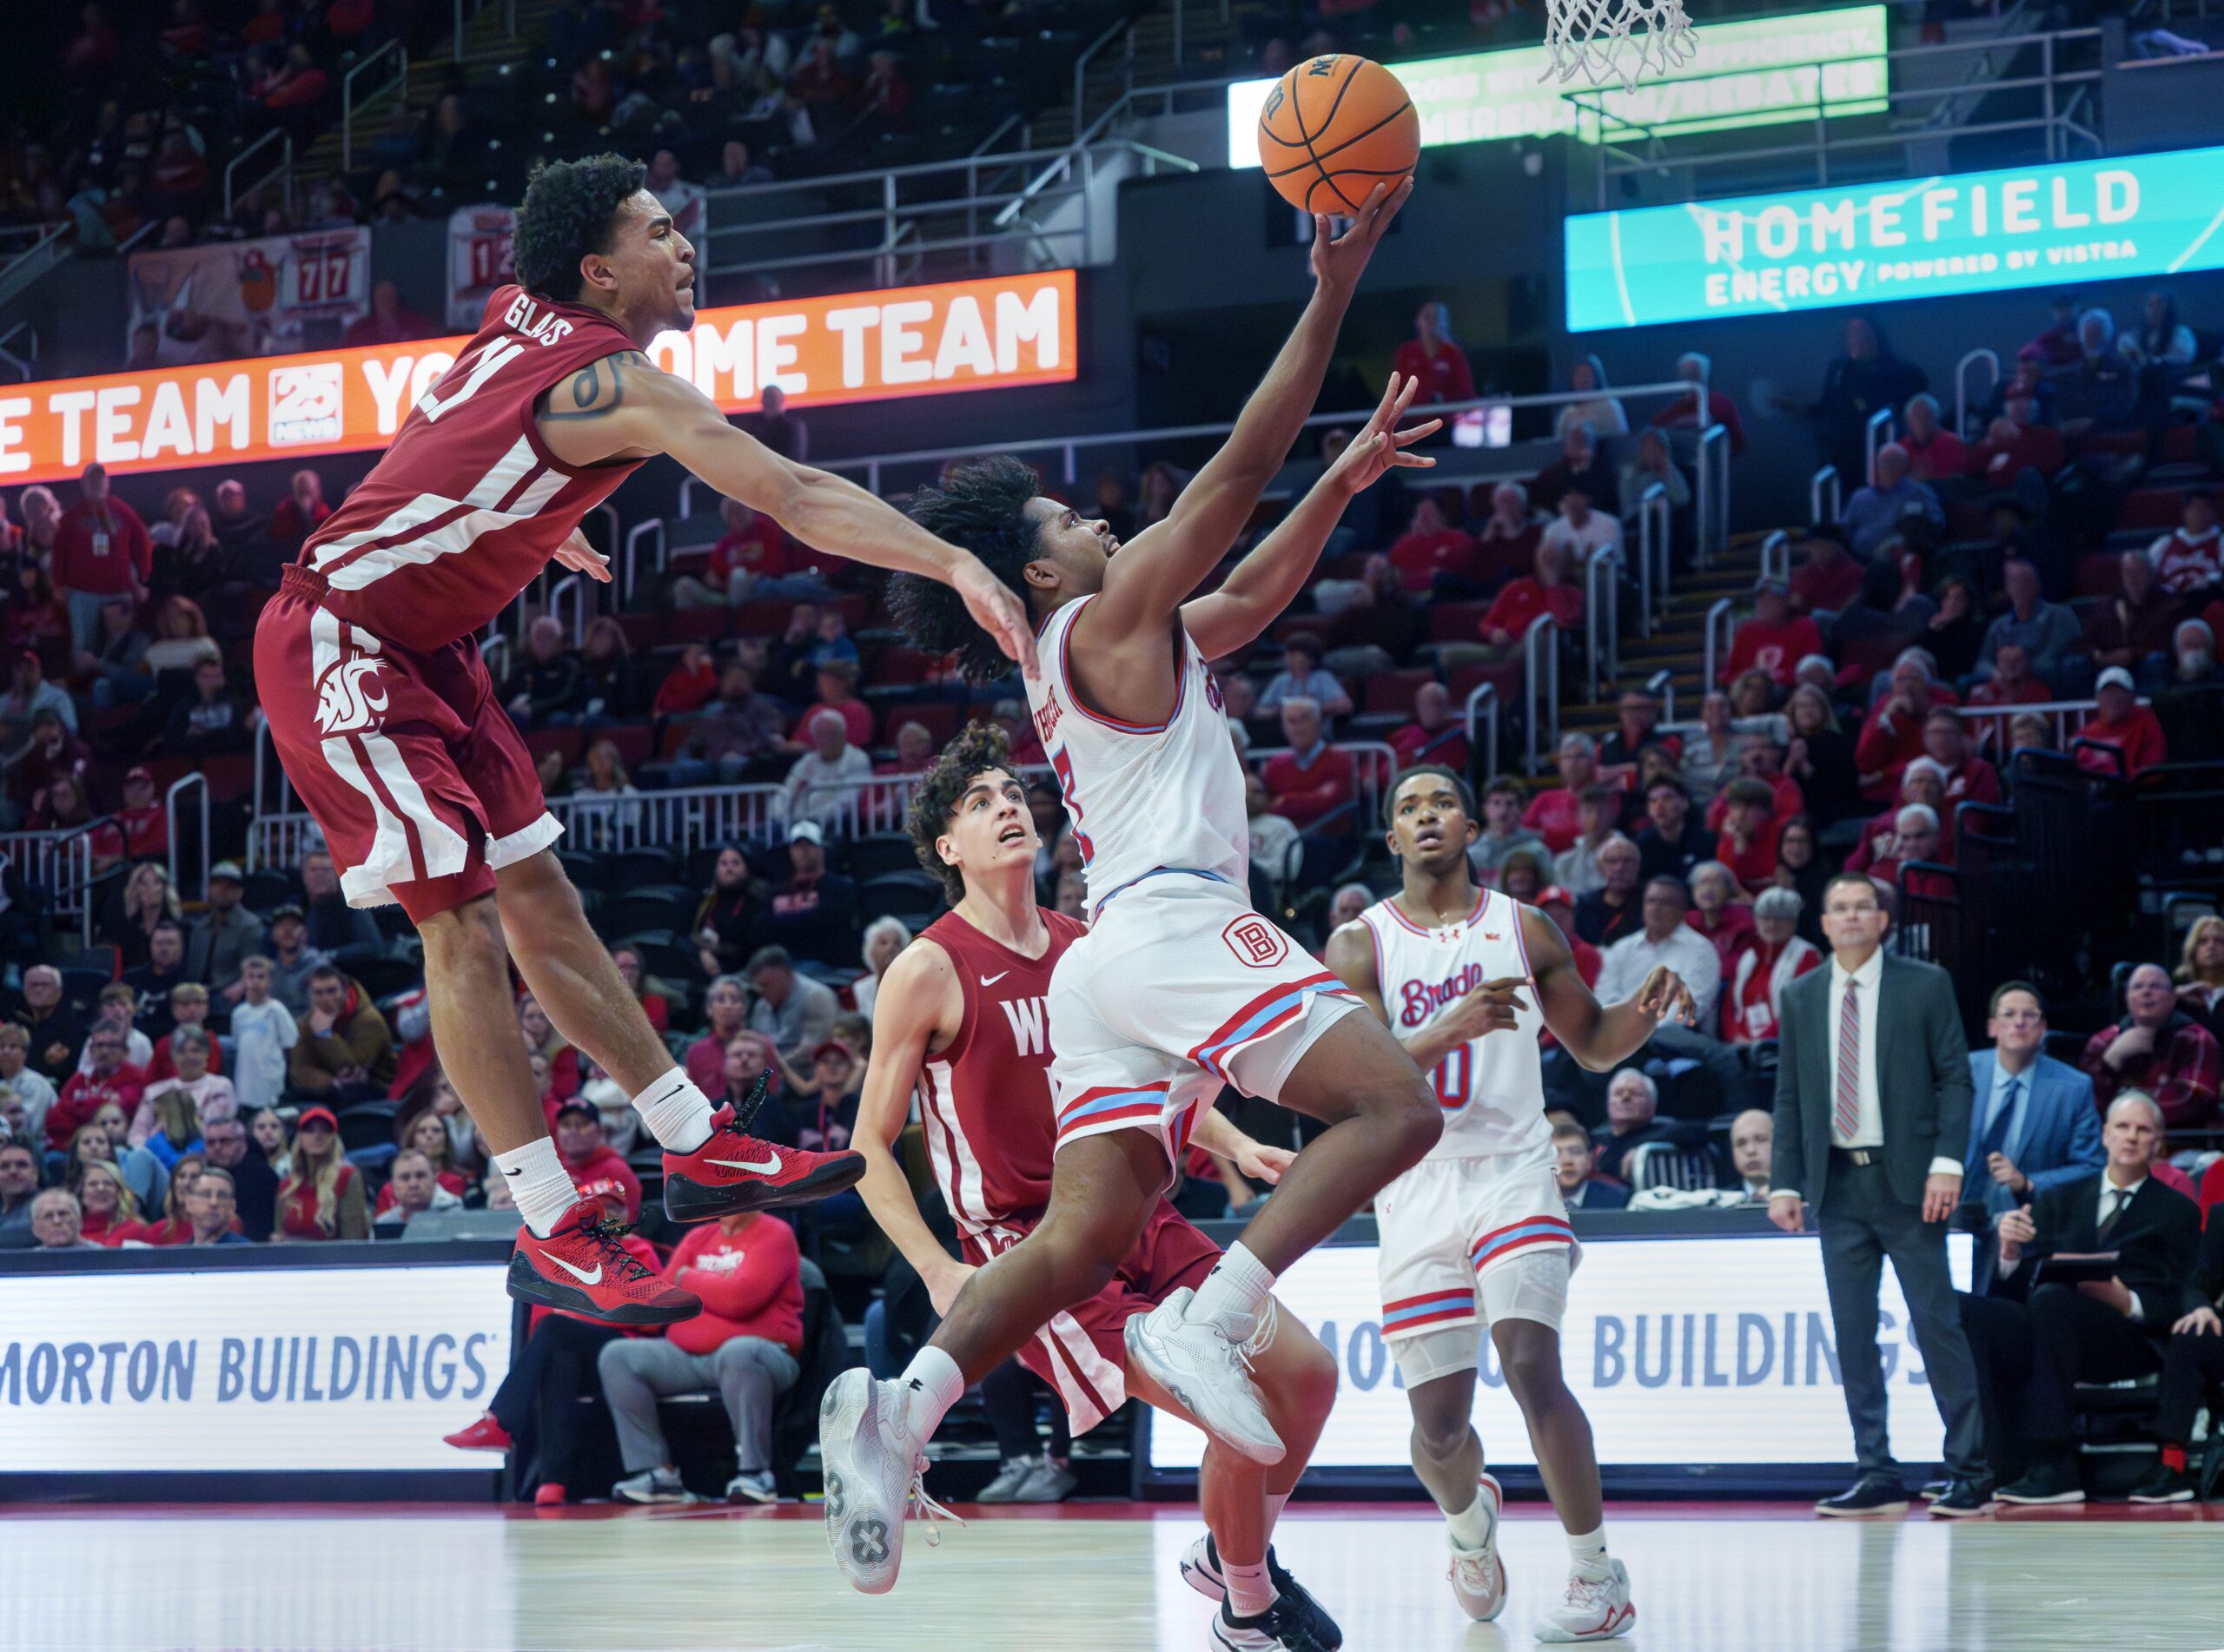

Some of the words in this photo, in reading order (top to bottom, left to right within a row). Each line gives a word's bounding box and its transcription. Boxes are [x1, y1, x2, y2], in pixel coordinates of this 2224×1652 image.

[1704, 169, 2141, 264] HOMEFIELD
[301, 256, 347, 297] 77
[1704, 260, 1865, 307] ENERGY
[1877, 253, 1998, 281] POWERED
[2006, 249, 2038, 269] BY
[2046, 240, 2138, 265] VISTRA
[649, 313, 808, 400] OME
[825, 287, 1060, 388] TEAM
[50, 373, 250, 467] TEAM
[274, 370, 339, 422] 25
[1233, 922, 1278, 963] B
[1433, 1041, 1475, 1112] 0
[217, 1333, 487, 1402] BUILDINGS
